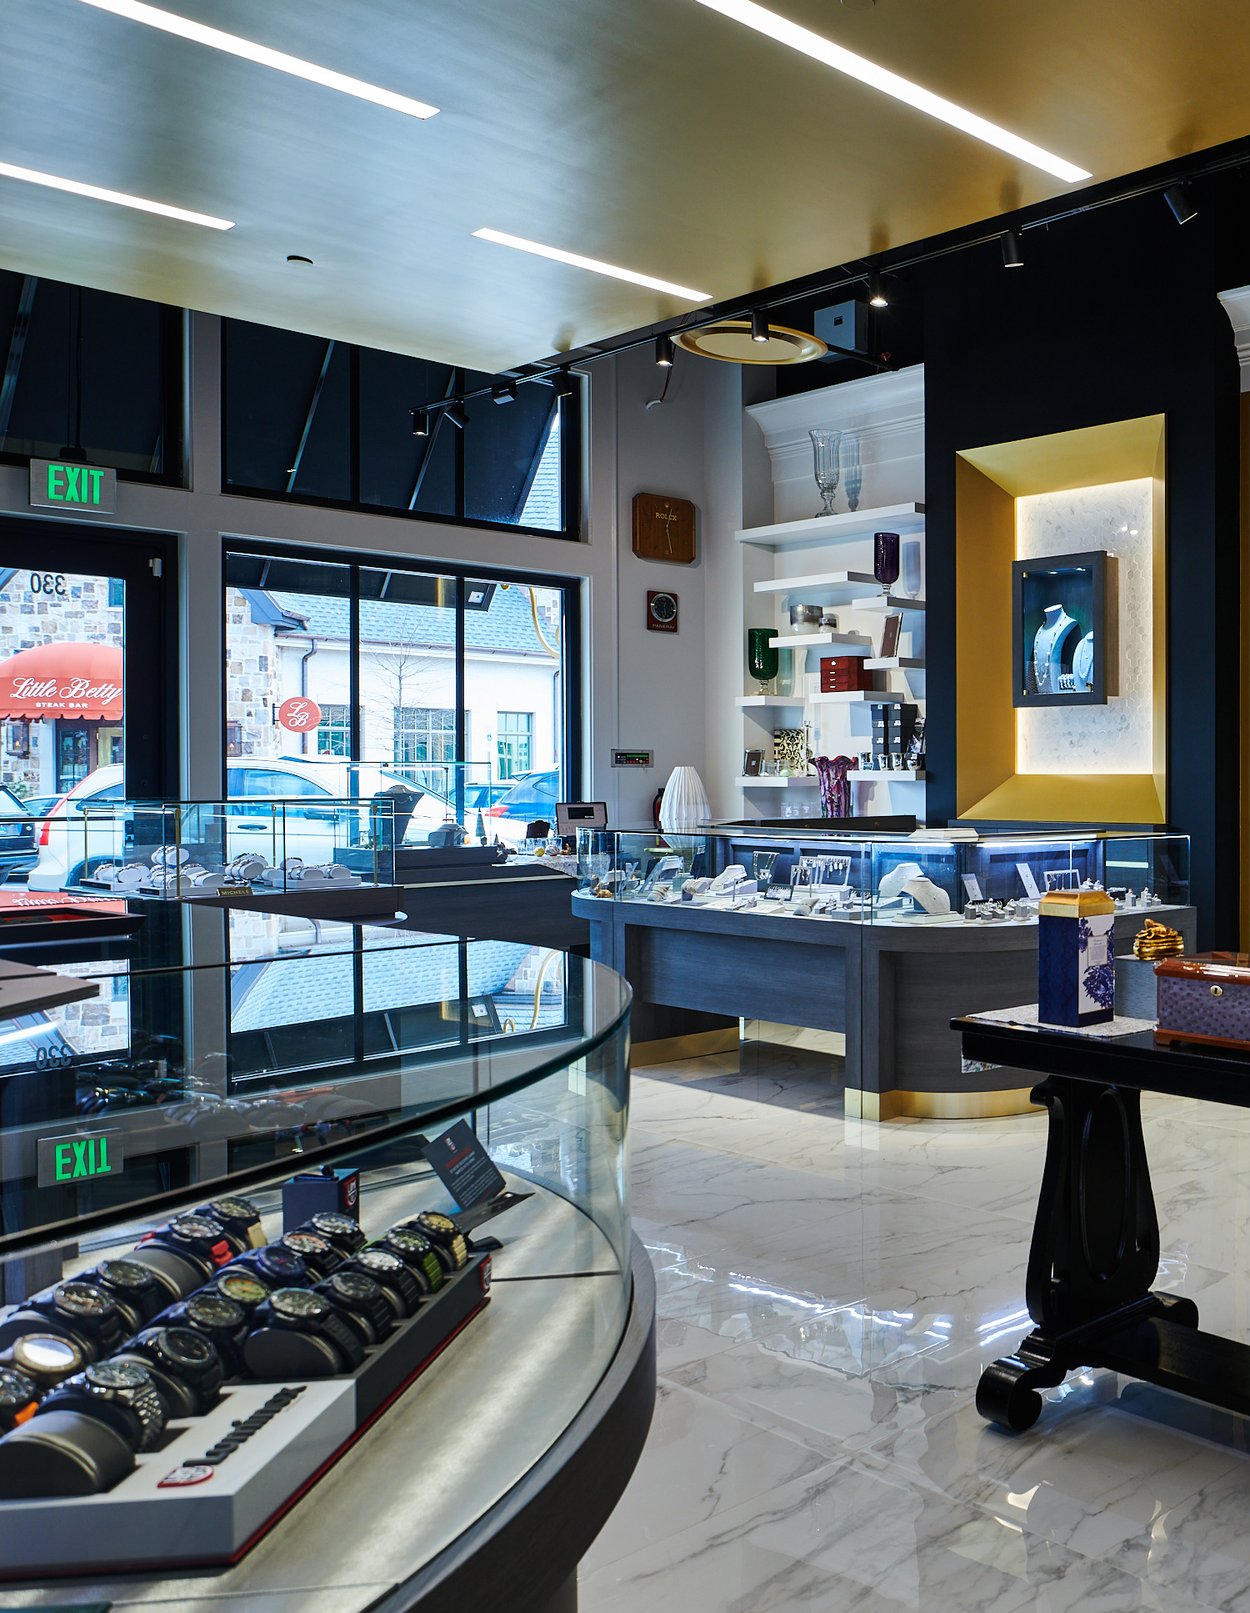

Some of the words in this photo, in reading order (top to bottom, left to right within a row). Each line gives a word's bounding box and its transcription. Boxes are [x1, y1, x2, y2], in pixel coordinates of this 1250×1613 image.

[47, 463, 104, 505] EXIT
[655, 512, 678, 521] ROLEX
[10, 678, 57, 699] Little
[59, 677, 123, 705] Betty
